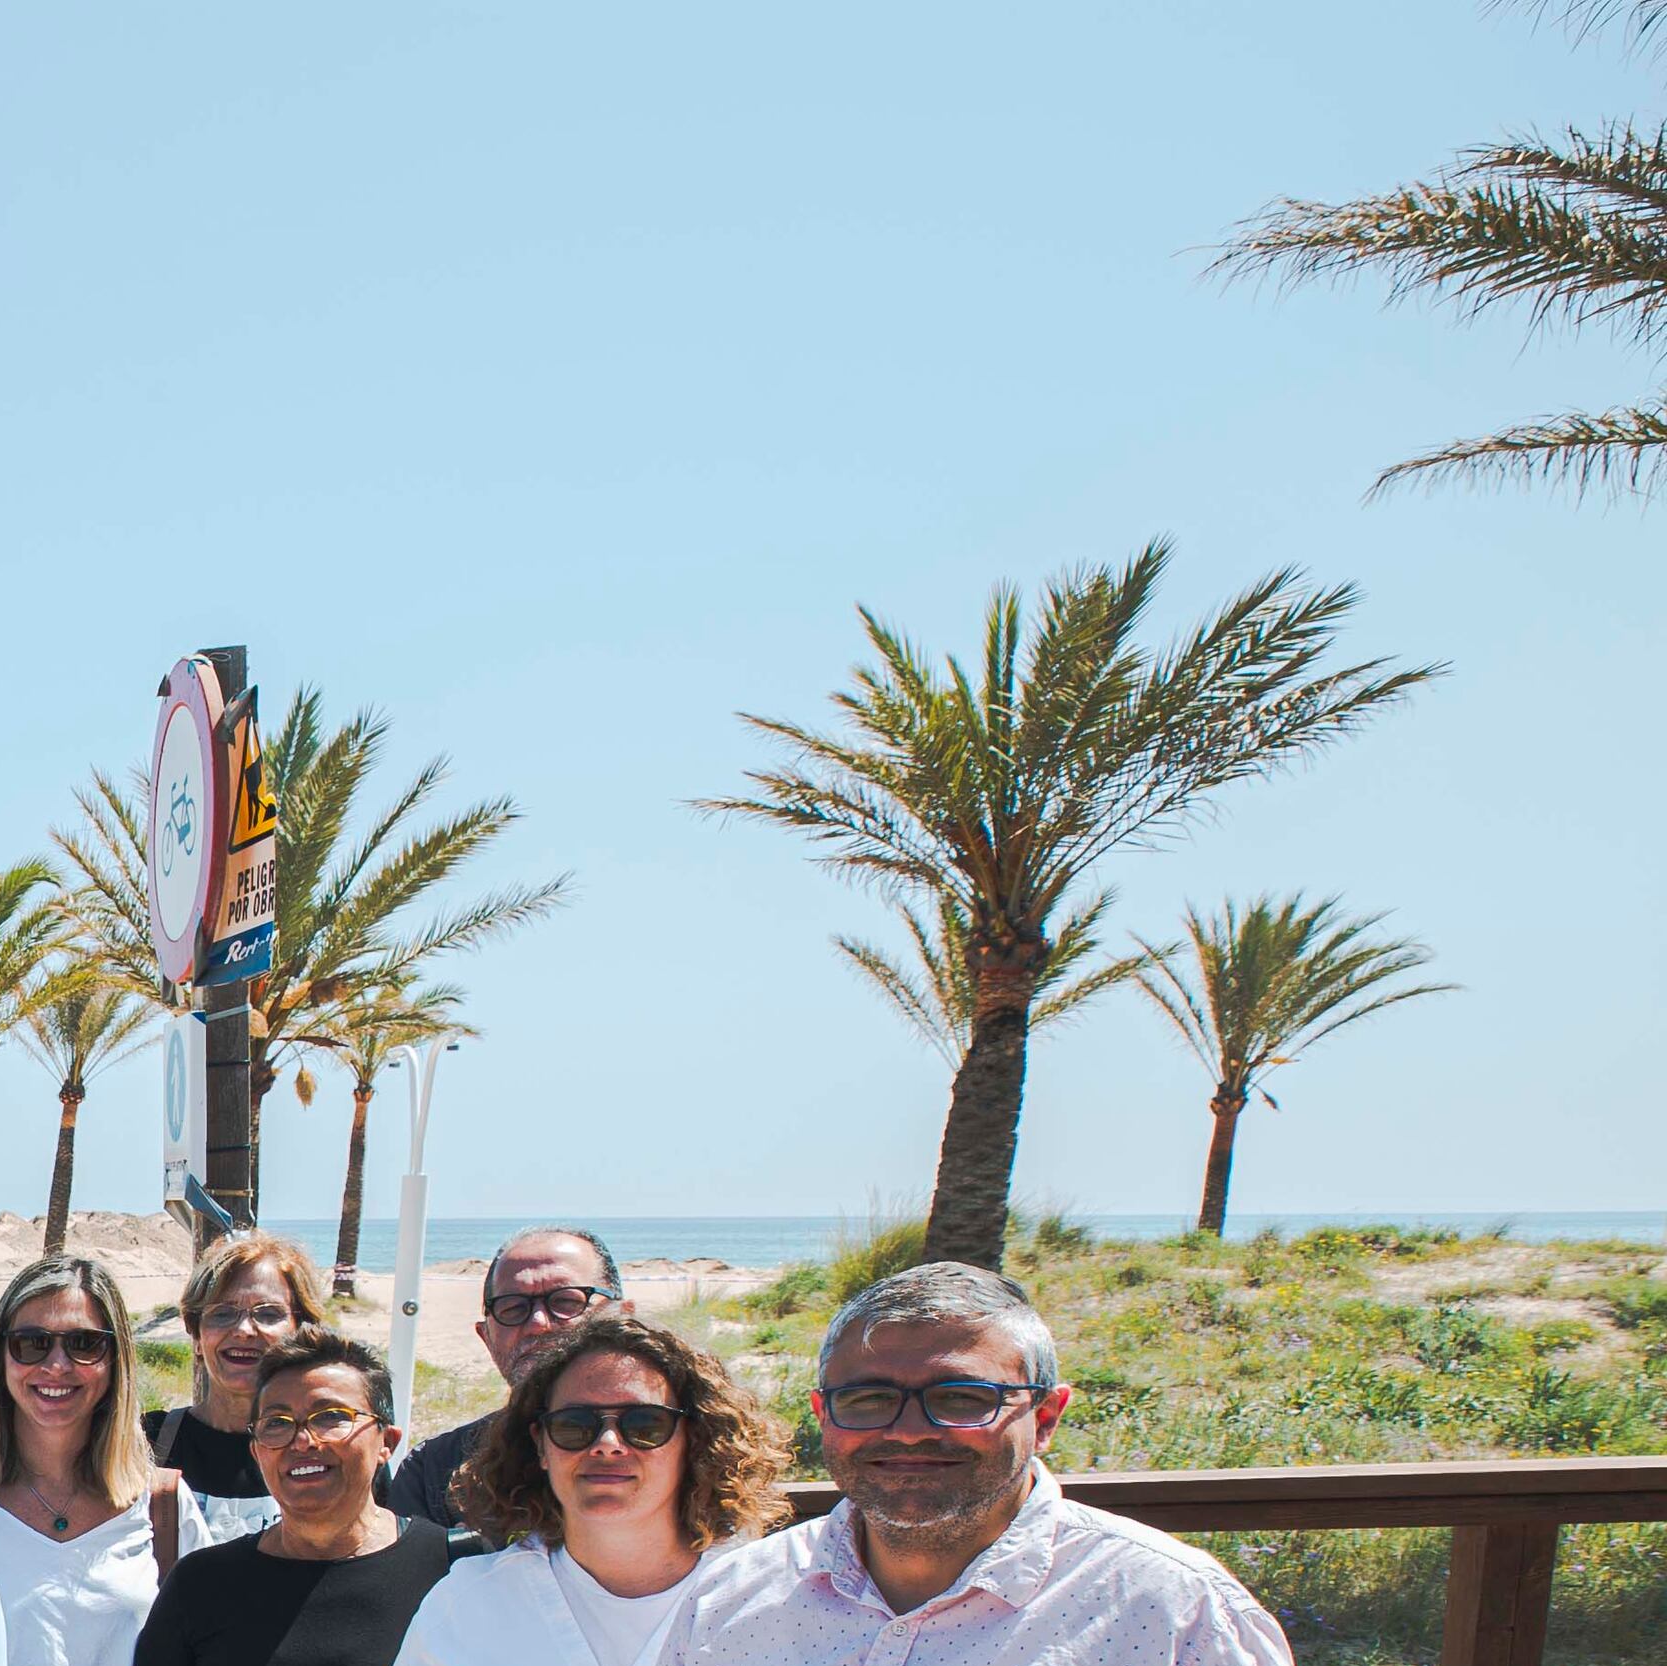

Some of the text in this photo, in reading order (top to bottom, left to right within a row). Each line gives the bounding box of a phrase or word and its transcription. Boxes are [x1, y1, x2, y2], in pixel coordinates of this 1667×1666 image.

[236, 858, 275, 898] PELIGR
[228, 886, 275, 926] POR OBR
